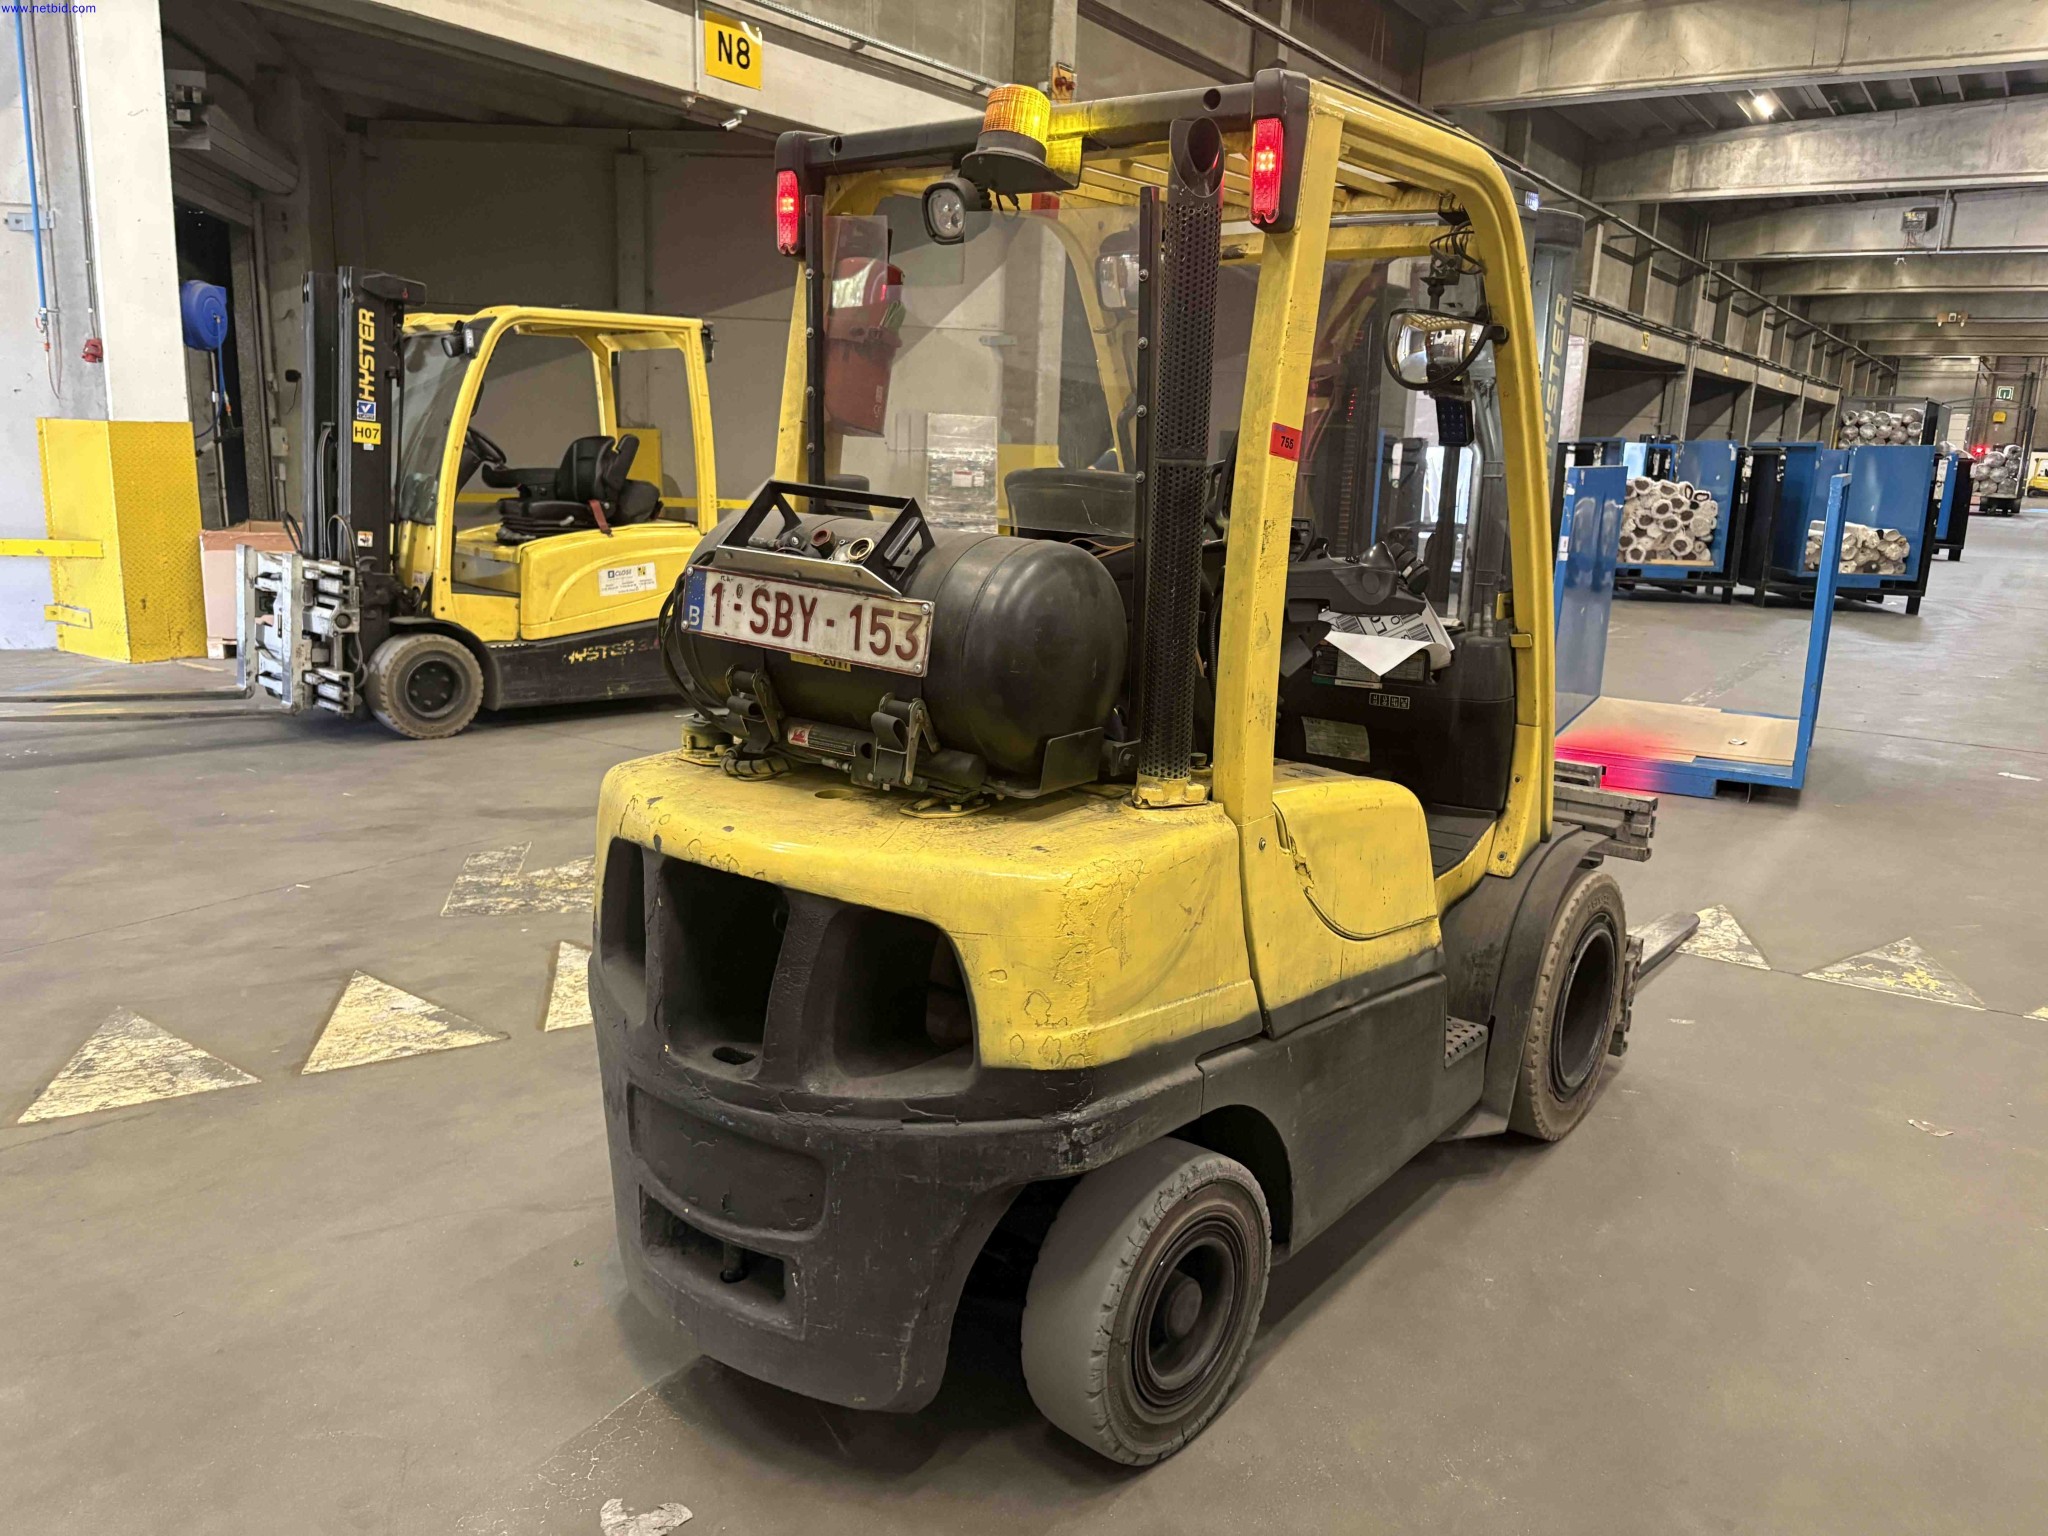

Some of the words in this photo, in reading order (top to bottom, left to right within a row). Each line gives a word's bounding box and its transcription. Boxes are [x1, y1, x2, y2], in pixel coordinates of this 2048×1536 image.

[718, 30, 751, 70] N8
[358, 308, 375, 401] HYSTER
[354, 426, 379, 439] H07
[689, 606, 700, 625] B
[711, 582, 922, 660] 1-SBY-153
